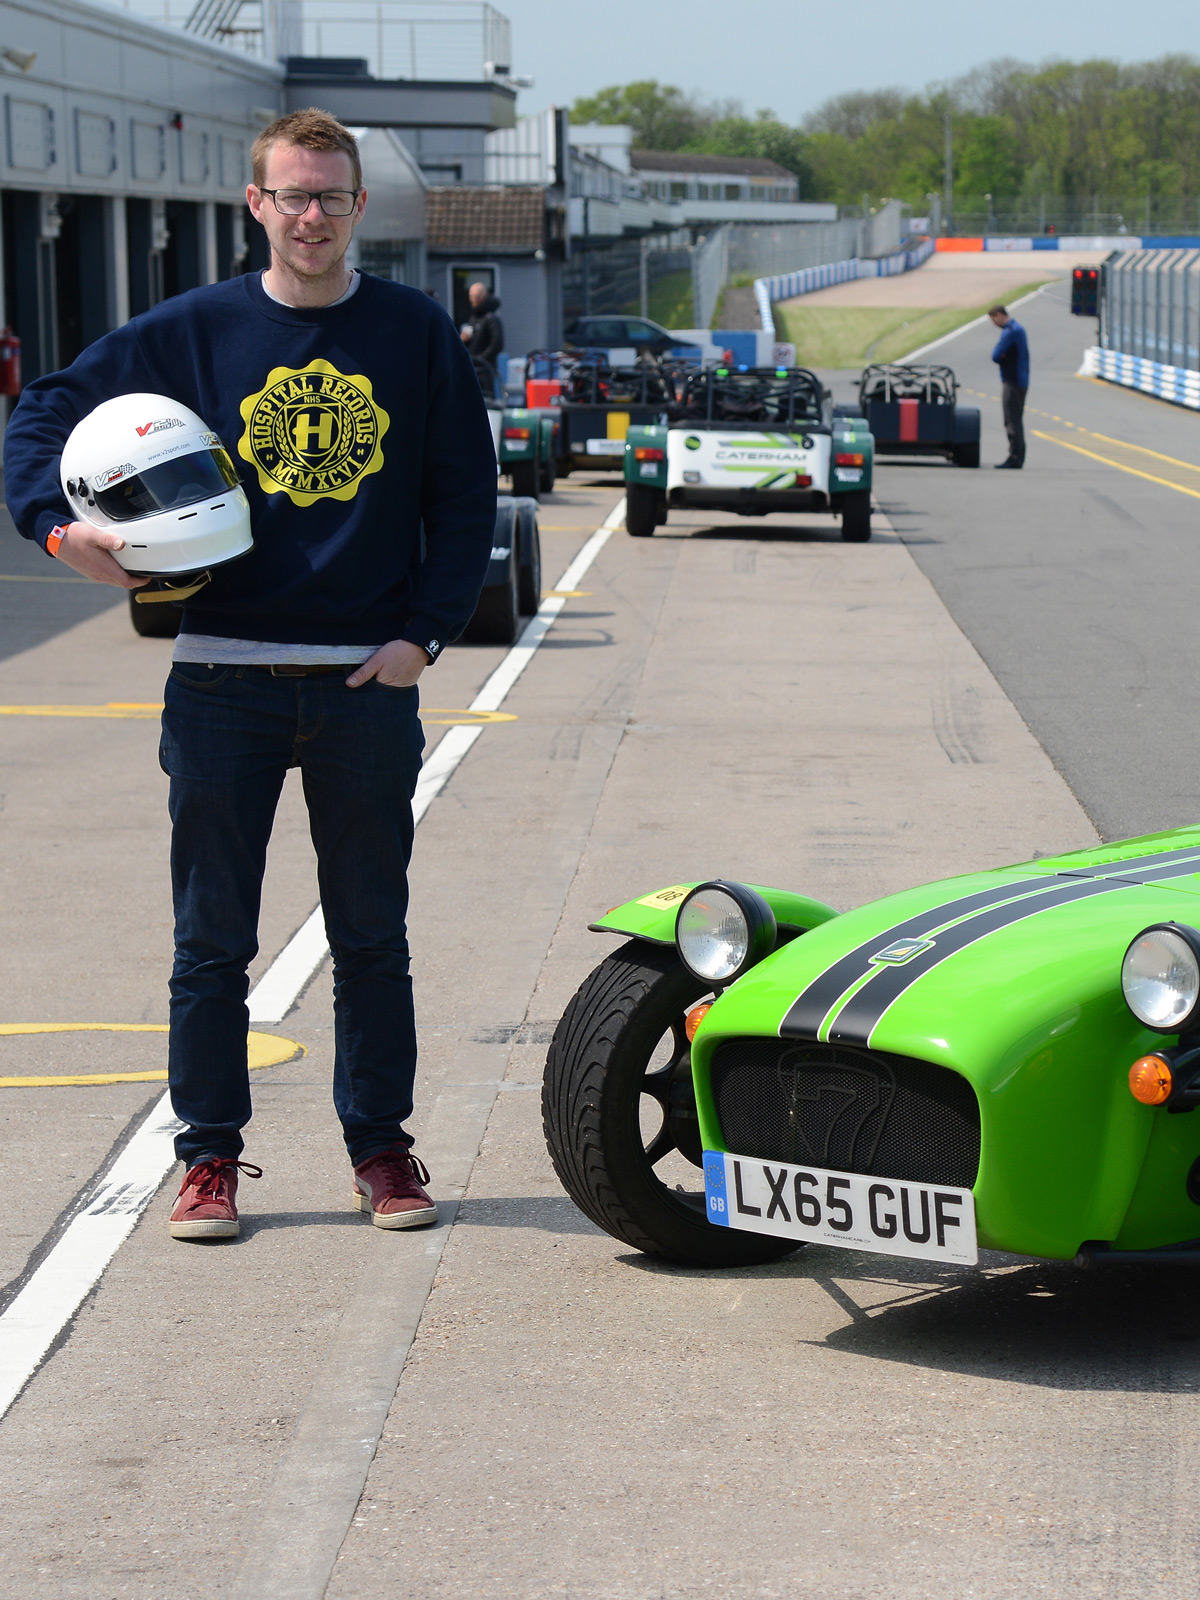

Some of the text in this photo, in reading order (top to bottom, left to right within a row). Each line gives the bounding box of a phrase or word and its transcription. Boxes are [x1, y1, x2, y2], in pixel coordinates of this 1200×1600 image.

[303, 396, 321, 404] NHS
[254, 377, 374, 450] HOSPITAL RECORDS
[293, 413, 333, 450] H
[147, 442, 191, 461] www.v2sport.com
[715, 451, 808, 461] CATERHAM
[270, 456, 362, 490] MCMXCVI
[709, 1196, 725, 1212] GB
[733, 1160, 962, 1247] LX65 GUF
